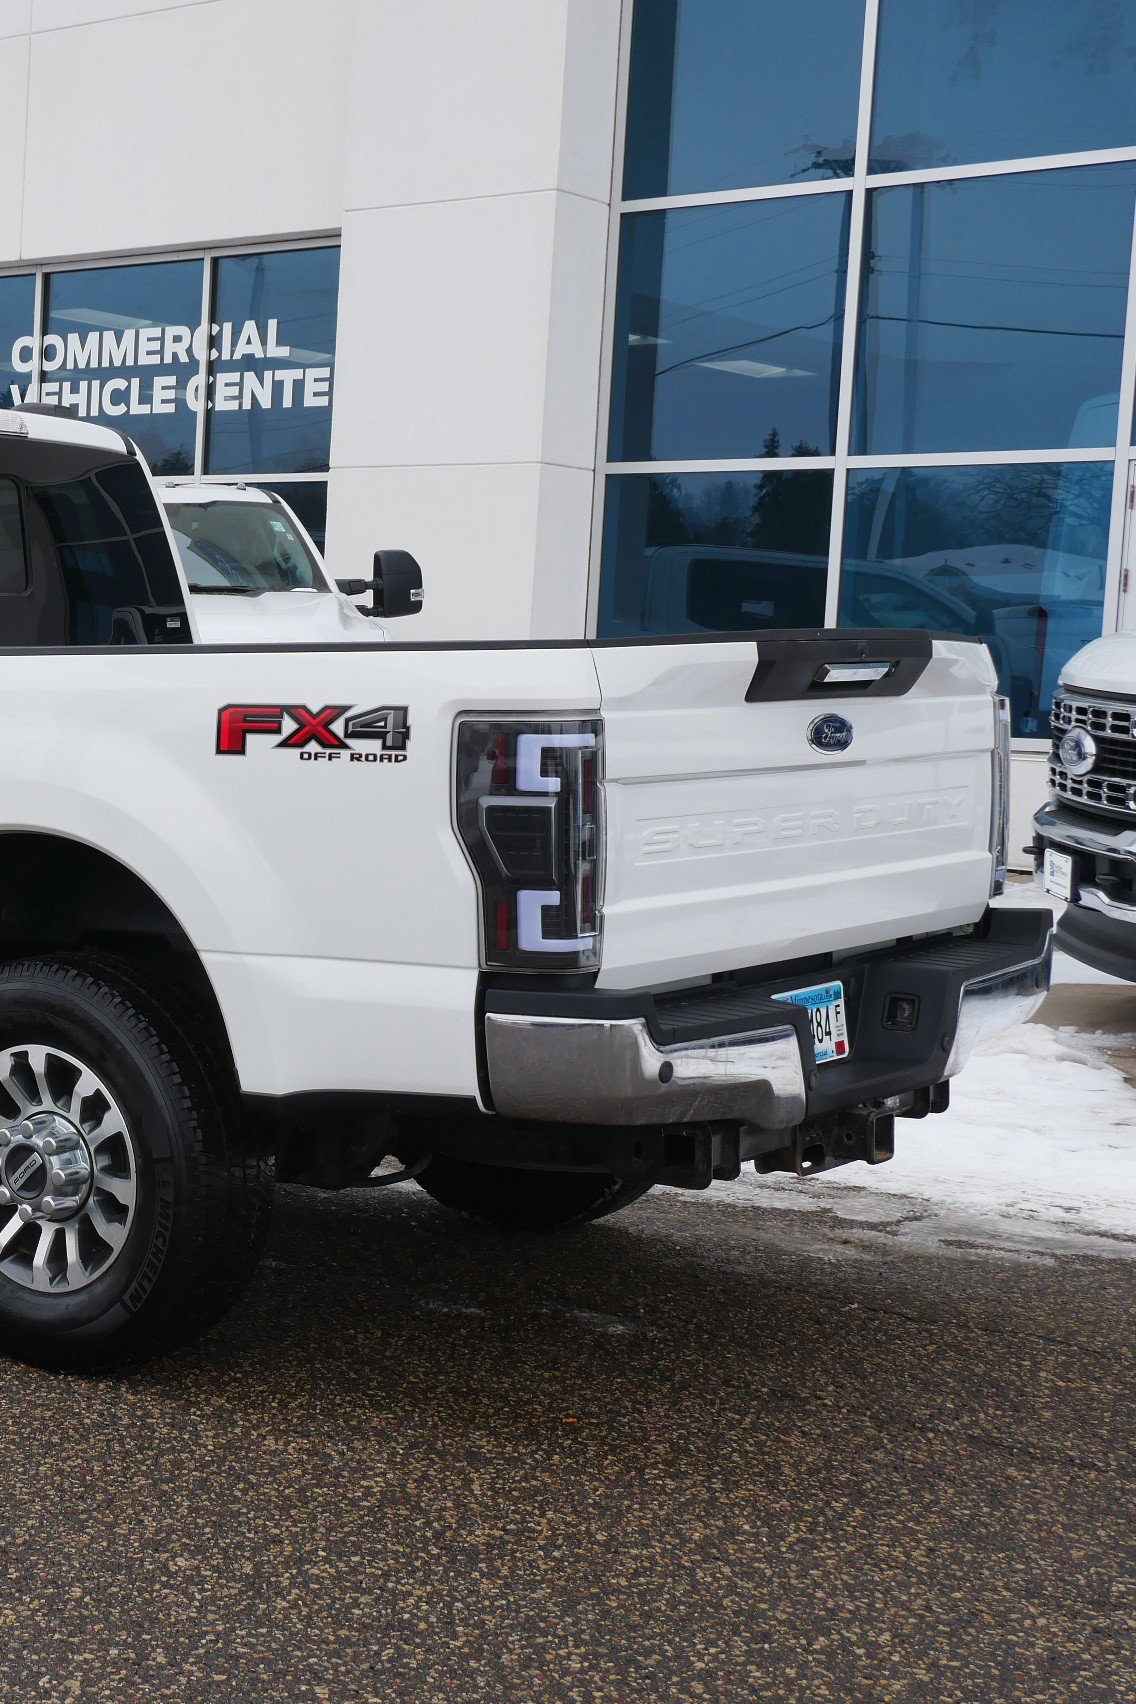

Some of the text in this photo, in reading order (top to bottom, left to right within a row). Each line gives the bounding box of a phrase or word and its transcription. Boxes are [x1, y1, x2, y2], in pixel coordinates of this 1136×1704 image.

[12, 319, 290, 373] COMMERCIAL
[10, 375, 177, 417] VEHICLE
[215, 703, 411, 755] FX4
[299, 751, 408, 763] OFF ROAD
[642, 794, 965, 854] SUPER DUTY
[14, 1159, 37, 1185] FORD
